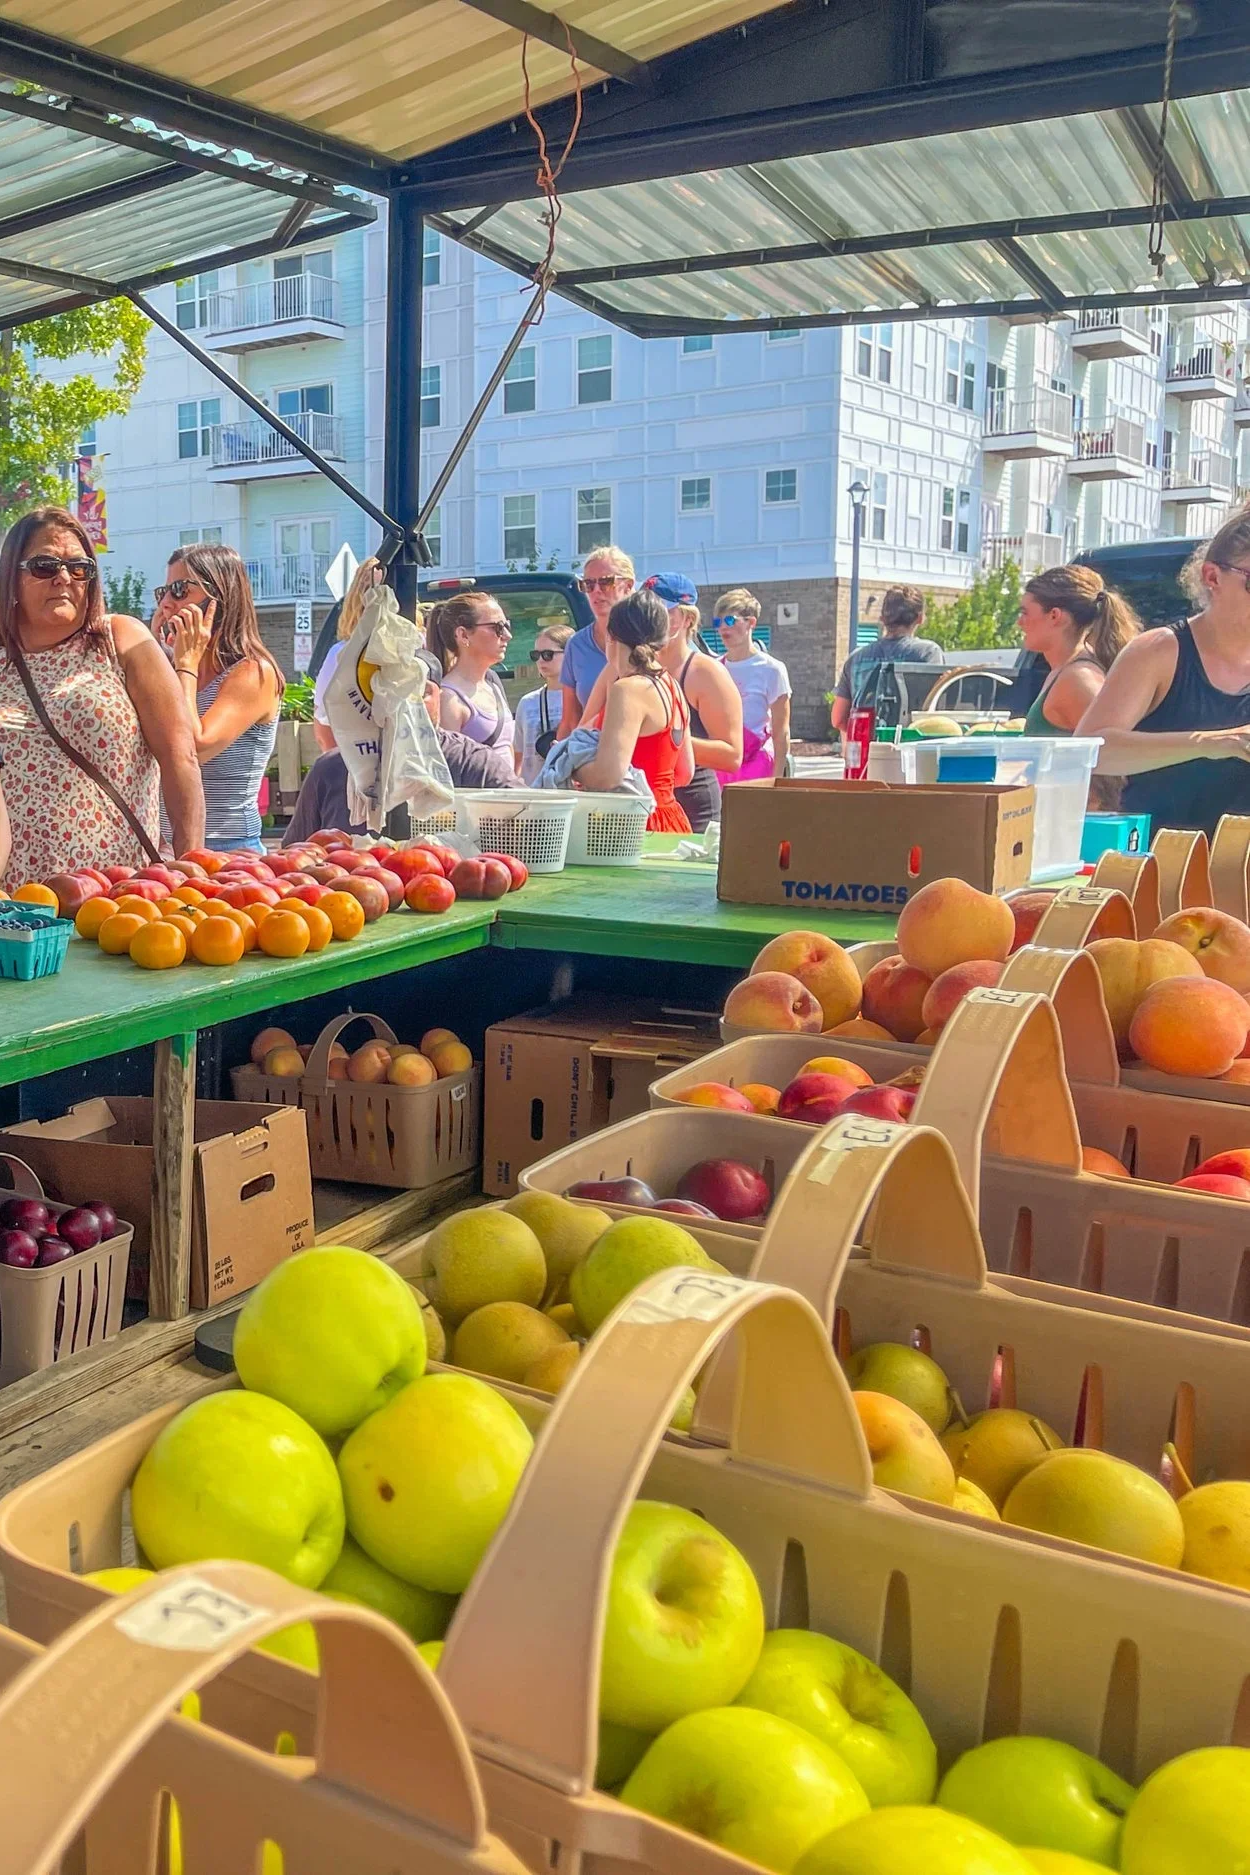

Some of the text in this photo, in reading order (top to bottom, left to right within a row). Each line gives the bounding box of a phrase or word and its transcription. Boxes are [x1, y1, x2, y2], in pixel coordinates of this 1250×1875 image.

[296, 616, 310, 630] 25
[782, 880, 909, 905] TOMATOES
[285, 1218, 309, 1236] PRODUCE
[294, 1231, 302, 1241] OF
